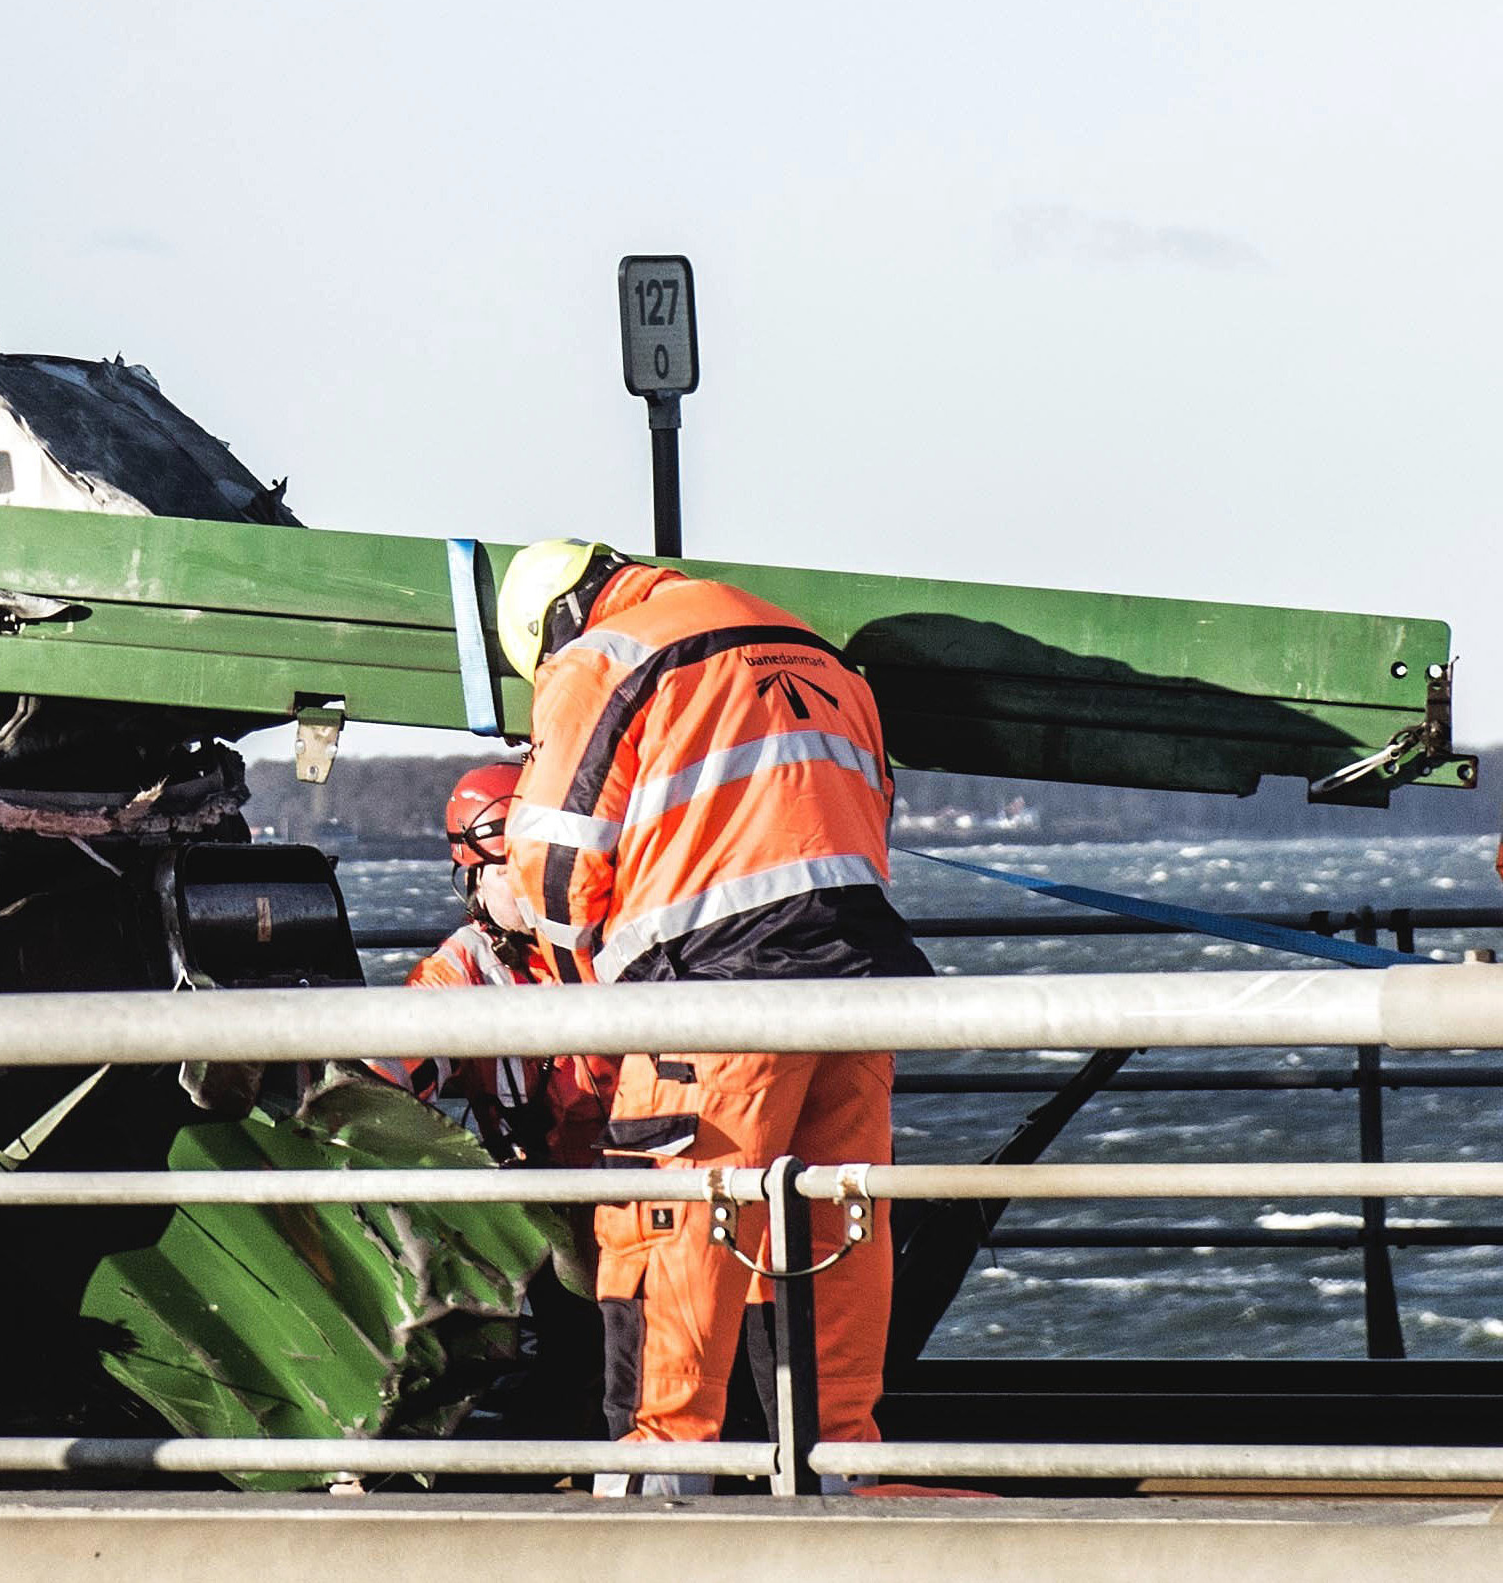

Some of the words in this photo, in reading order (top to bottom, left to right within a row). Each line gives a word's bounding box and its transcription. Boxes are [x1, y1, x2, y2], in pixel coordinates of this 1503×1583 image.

[634, 279, 680, 326] 127
[654, 344, 670, 380] 0
[743, 652, 826, 668] banedanmark
